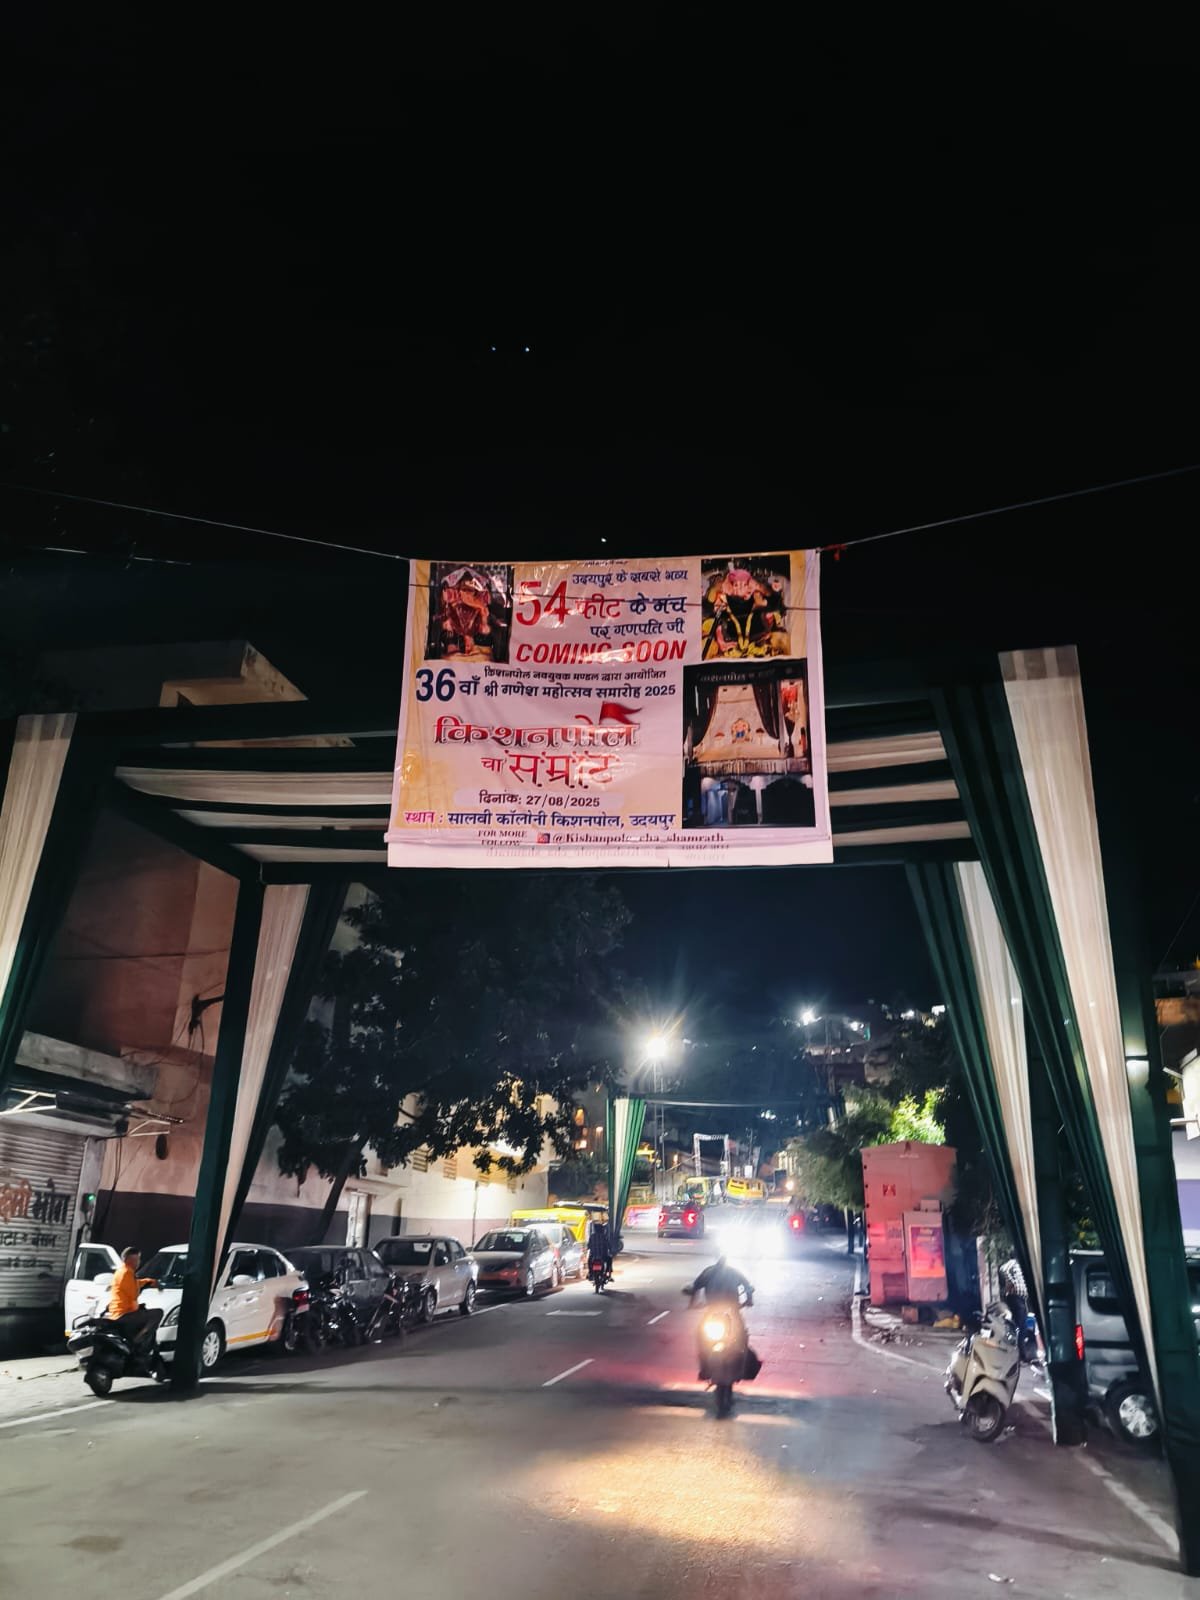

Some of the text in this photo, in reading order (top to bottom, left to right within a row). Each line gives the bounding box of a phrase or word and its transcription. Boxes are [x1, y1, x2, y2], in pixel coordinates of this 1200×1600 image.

[572, 568, 688, 587] उदयपुर के सबसे भव्य
[516, 580, 687, 626] 54 फीट के मंच
[590, 618, 686, 639] पर गणपति जी
[622, 640, 687, 663] SOON
[624, 668, 667, 680] आयोजित
[415, 668, 676, 702] 36 वाँ श्री गणेश महोत्सव समारोह 2025
[433, 714, 640, 747] किशनपोल
[480, 757, 503, 773] चा
[479, 788, 600, 808] दिनांक: 27/08/2025
[405, 811, 435, 823] स्थान
[447, 809, 493, 825] सालवी
[496, 808, 548, 826] कॉलोनी
[551, 811, 625, 829] किशनपोल,
[629, 813, 677, 830] उदयपुर
